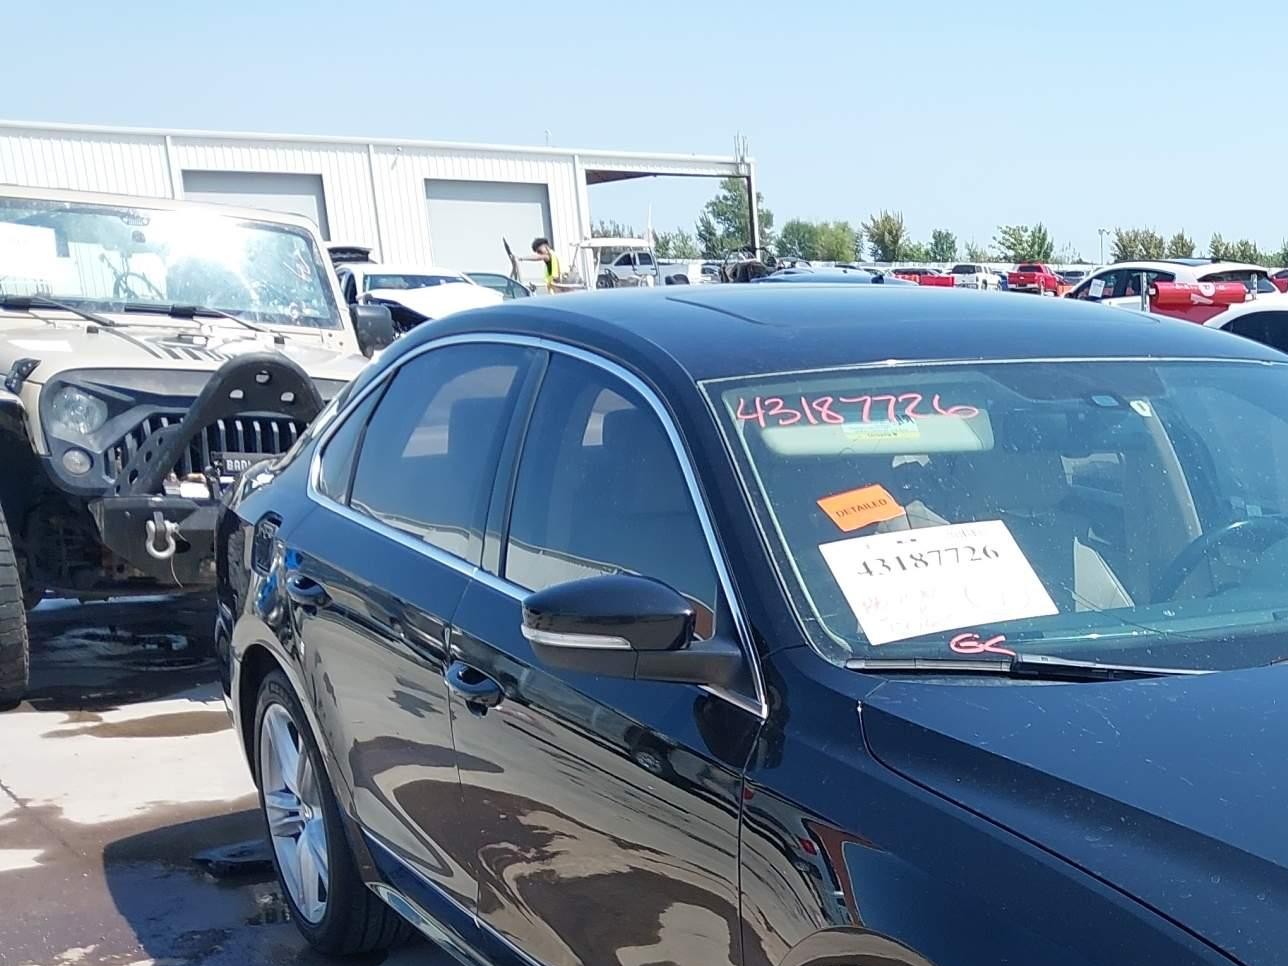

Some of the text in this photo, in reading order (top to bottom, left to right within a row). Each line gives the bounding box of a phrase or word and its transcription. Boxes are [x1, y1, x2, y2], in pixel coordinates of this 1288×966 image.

[736, 393, 980, 428] 43187726
[835, 499, 888, 518] DETAILED
[857, 545, 1000, 577] 43187726
